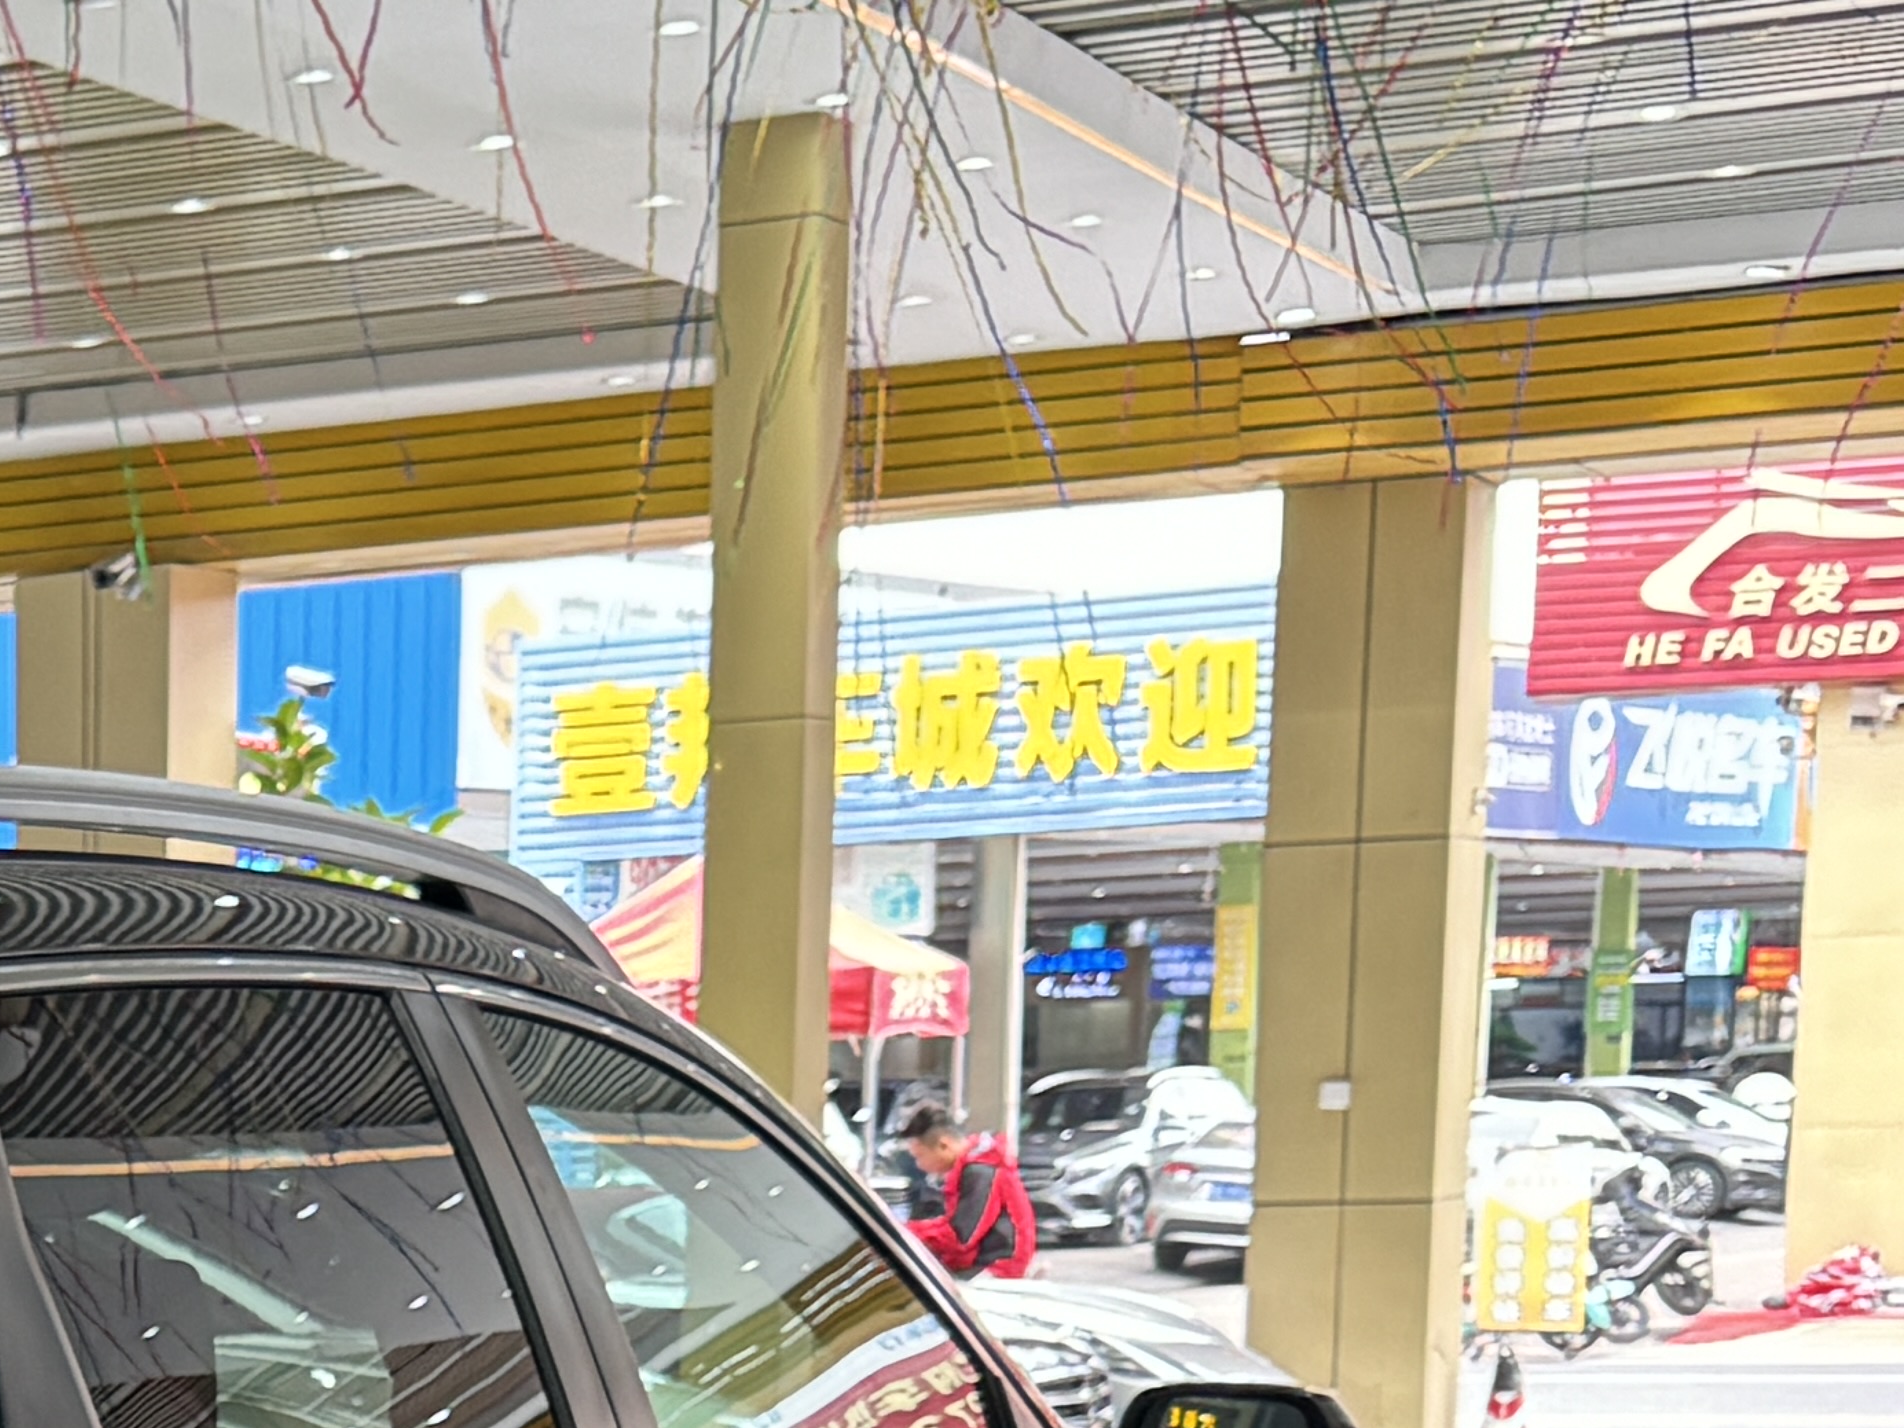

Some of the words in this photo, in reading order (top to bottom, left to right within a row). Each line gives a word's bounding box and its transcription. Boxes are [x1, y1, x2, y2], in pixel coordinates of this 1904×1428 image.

[1728, 561, 1904, 619] 合发二
[1624, 631, 1681, 668] HE
[1699, 625, 1754, 663] FA
[1775, 620, 1901, 659] USED
